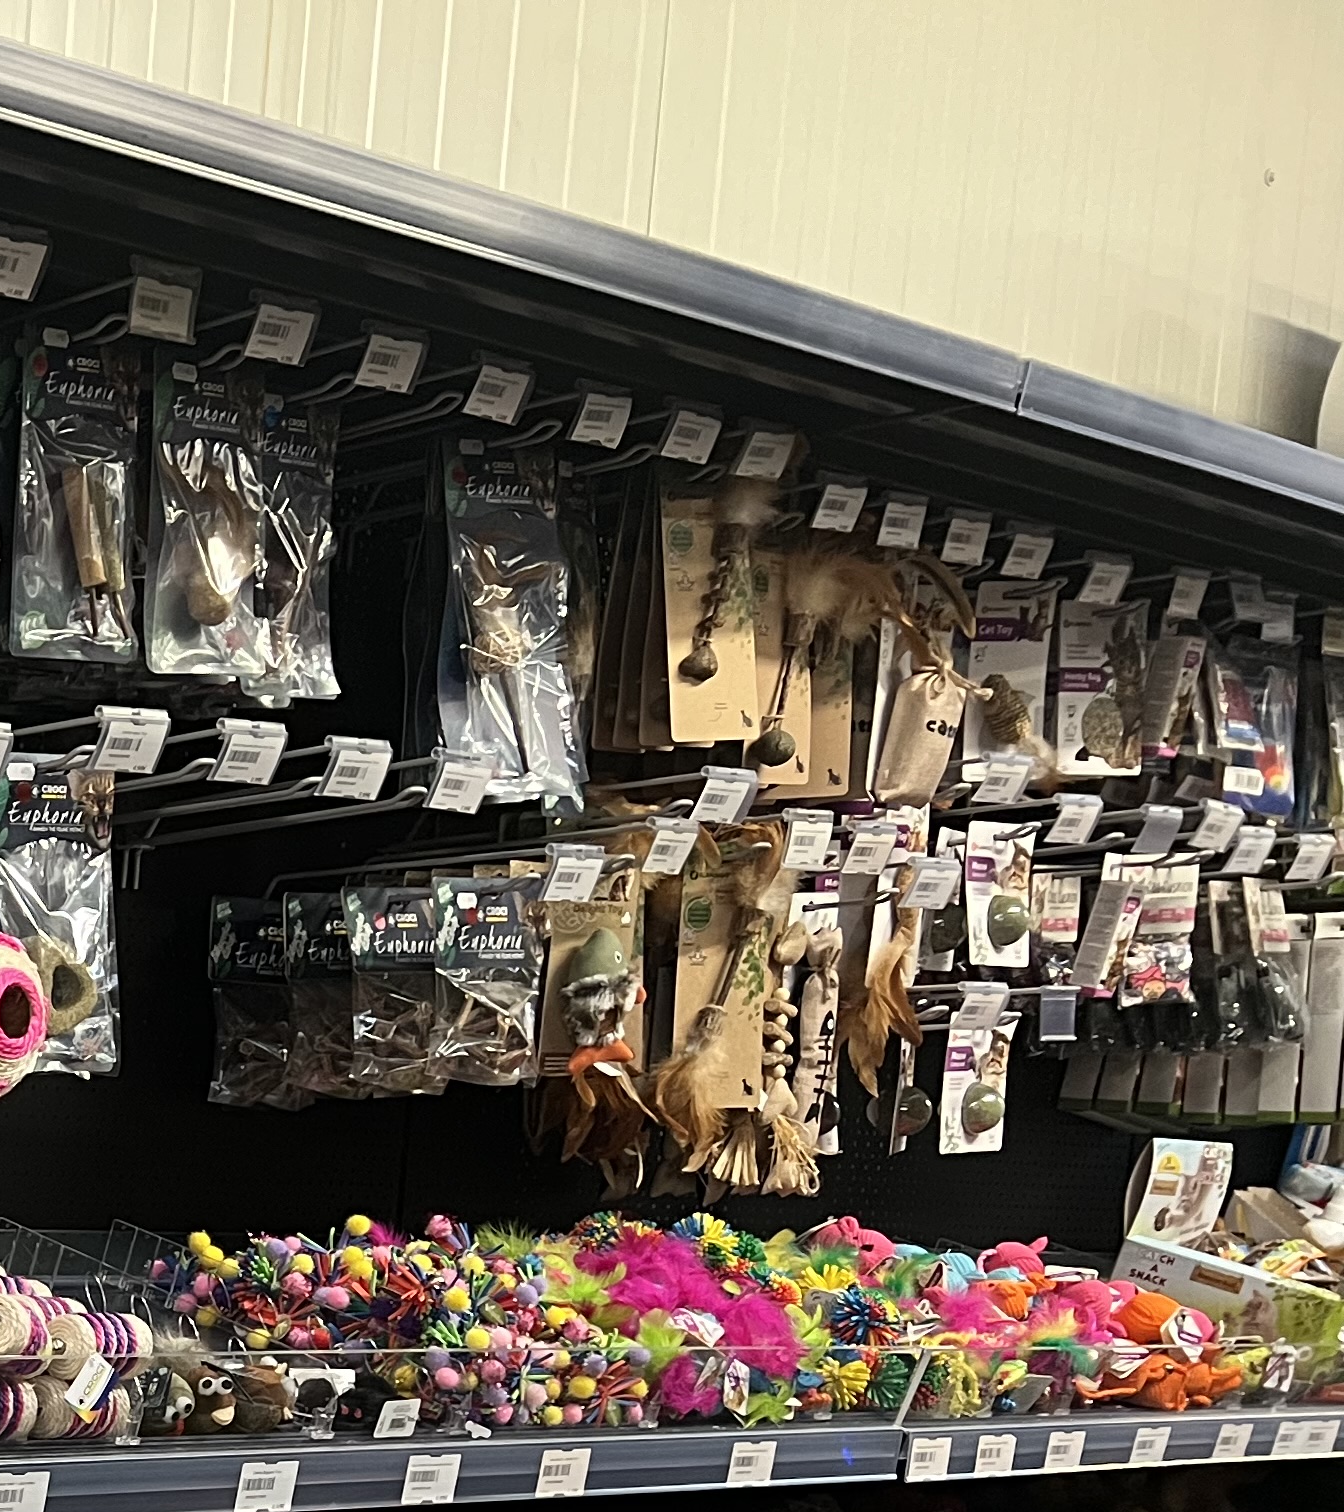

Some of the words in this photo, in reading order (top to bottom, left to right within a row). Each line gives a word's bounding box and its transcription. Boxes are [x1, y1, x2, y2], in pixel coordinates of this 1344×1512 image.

[45, 371, 115, 402] Euphoria
[173, 395, 239, 425] Euphoria
[466, 475, 529, 500] Euphoria
[41, 785, 68, 795] CROCI
[8, 801, 84, 829] Euphoria
[486, 906, 508, 917] CROCI
[458, 925, 522, 953] Euphoria
[1128, 1269, 1167, 1287] SNACK
[83, 1363, 105, 1396] CROCI
